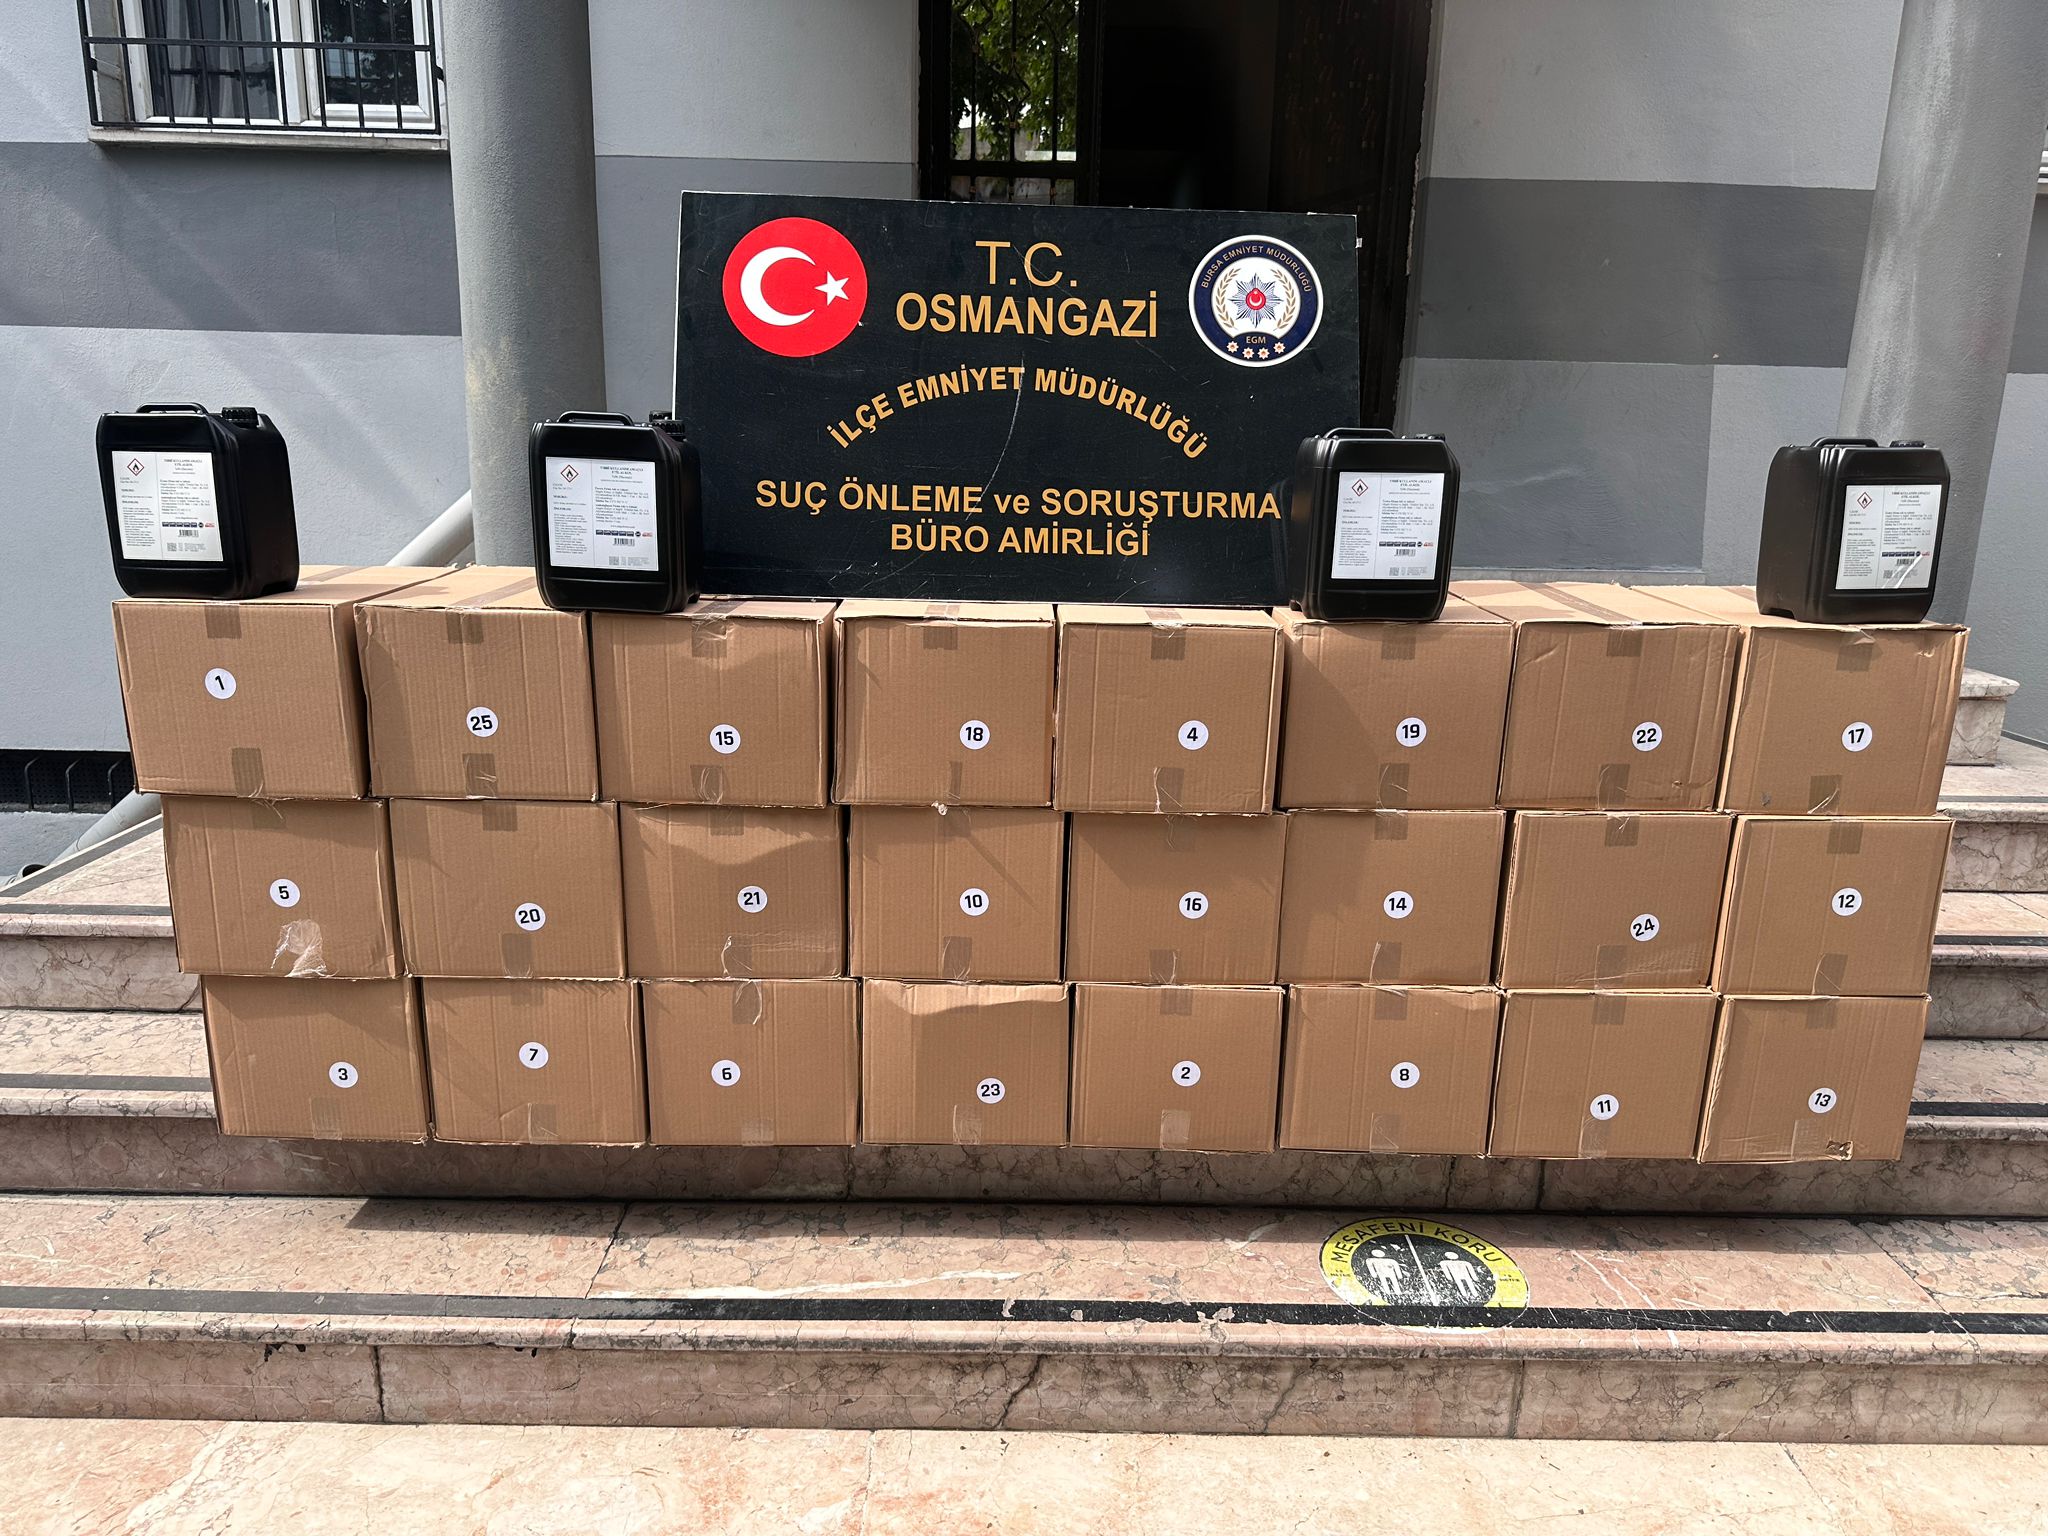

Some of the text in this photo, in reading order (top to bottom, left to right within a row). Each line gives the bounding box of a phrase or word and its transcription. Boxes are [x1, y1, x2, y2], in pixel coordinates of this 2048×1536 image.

[975, 240, 1078, 287] T.C.
[1201, 259, 1223, 288] BURSA
[1223, 245, 1264, 262] EMNİYET
[896, 290, 1158, 338] OSMANGAZİ
[1246, 336, 1266, 344] EGM
[826, 364, 1208, 459] İLÇE EMNİYET MÜDÜRLÜĞÜ
[755, 476, 1282, 522] SUÇ ÖNLEME ve SORUŞTURMA
[891, 520, 1151, 557] BÜRO AMİRLİĞİ
[214, 675, 225, 691] 1
[470, 714, 493, 732] 25
[715, 731, 734, 746] 15
[965, 726, 984, 742] 18
[1186, 727, 1199, 742] 4
[1401, 723, 1420, 739] 19
[1636, 727, 1657, 745] 22
[1848, 727, 1865, 744] 17
[278, 885, 290, 900] 5
[743, 891, 761, 906] 21
[964, 894, 983, 909] 10
[1184, 897, 1202, 912] 16
[1388, 897, 1408, 912] 14
[1838, 894, 1856, 909] 12
[518, 908, 541, 925] 20
[1632, 918, 1656, 938] 24
[529, 1048, 539, 1062] 7
[337, 1067, 349, 1081] 3
[721, 1067, 733, 1081] 6
[1180, 1066, 1191, 1080] 2
[1399, 1068, 1410, 1082] 8
[980, 1083, 1001, 1098] 23
[1597, 1099, 1611, 1114] 11
[1814, 1092, 1832, 1107] 13
[1434, 1227, 1503, 1262] KORU
